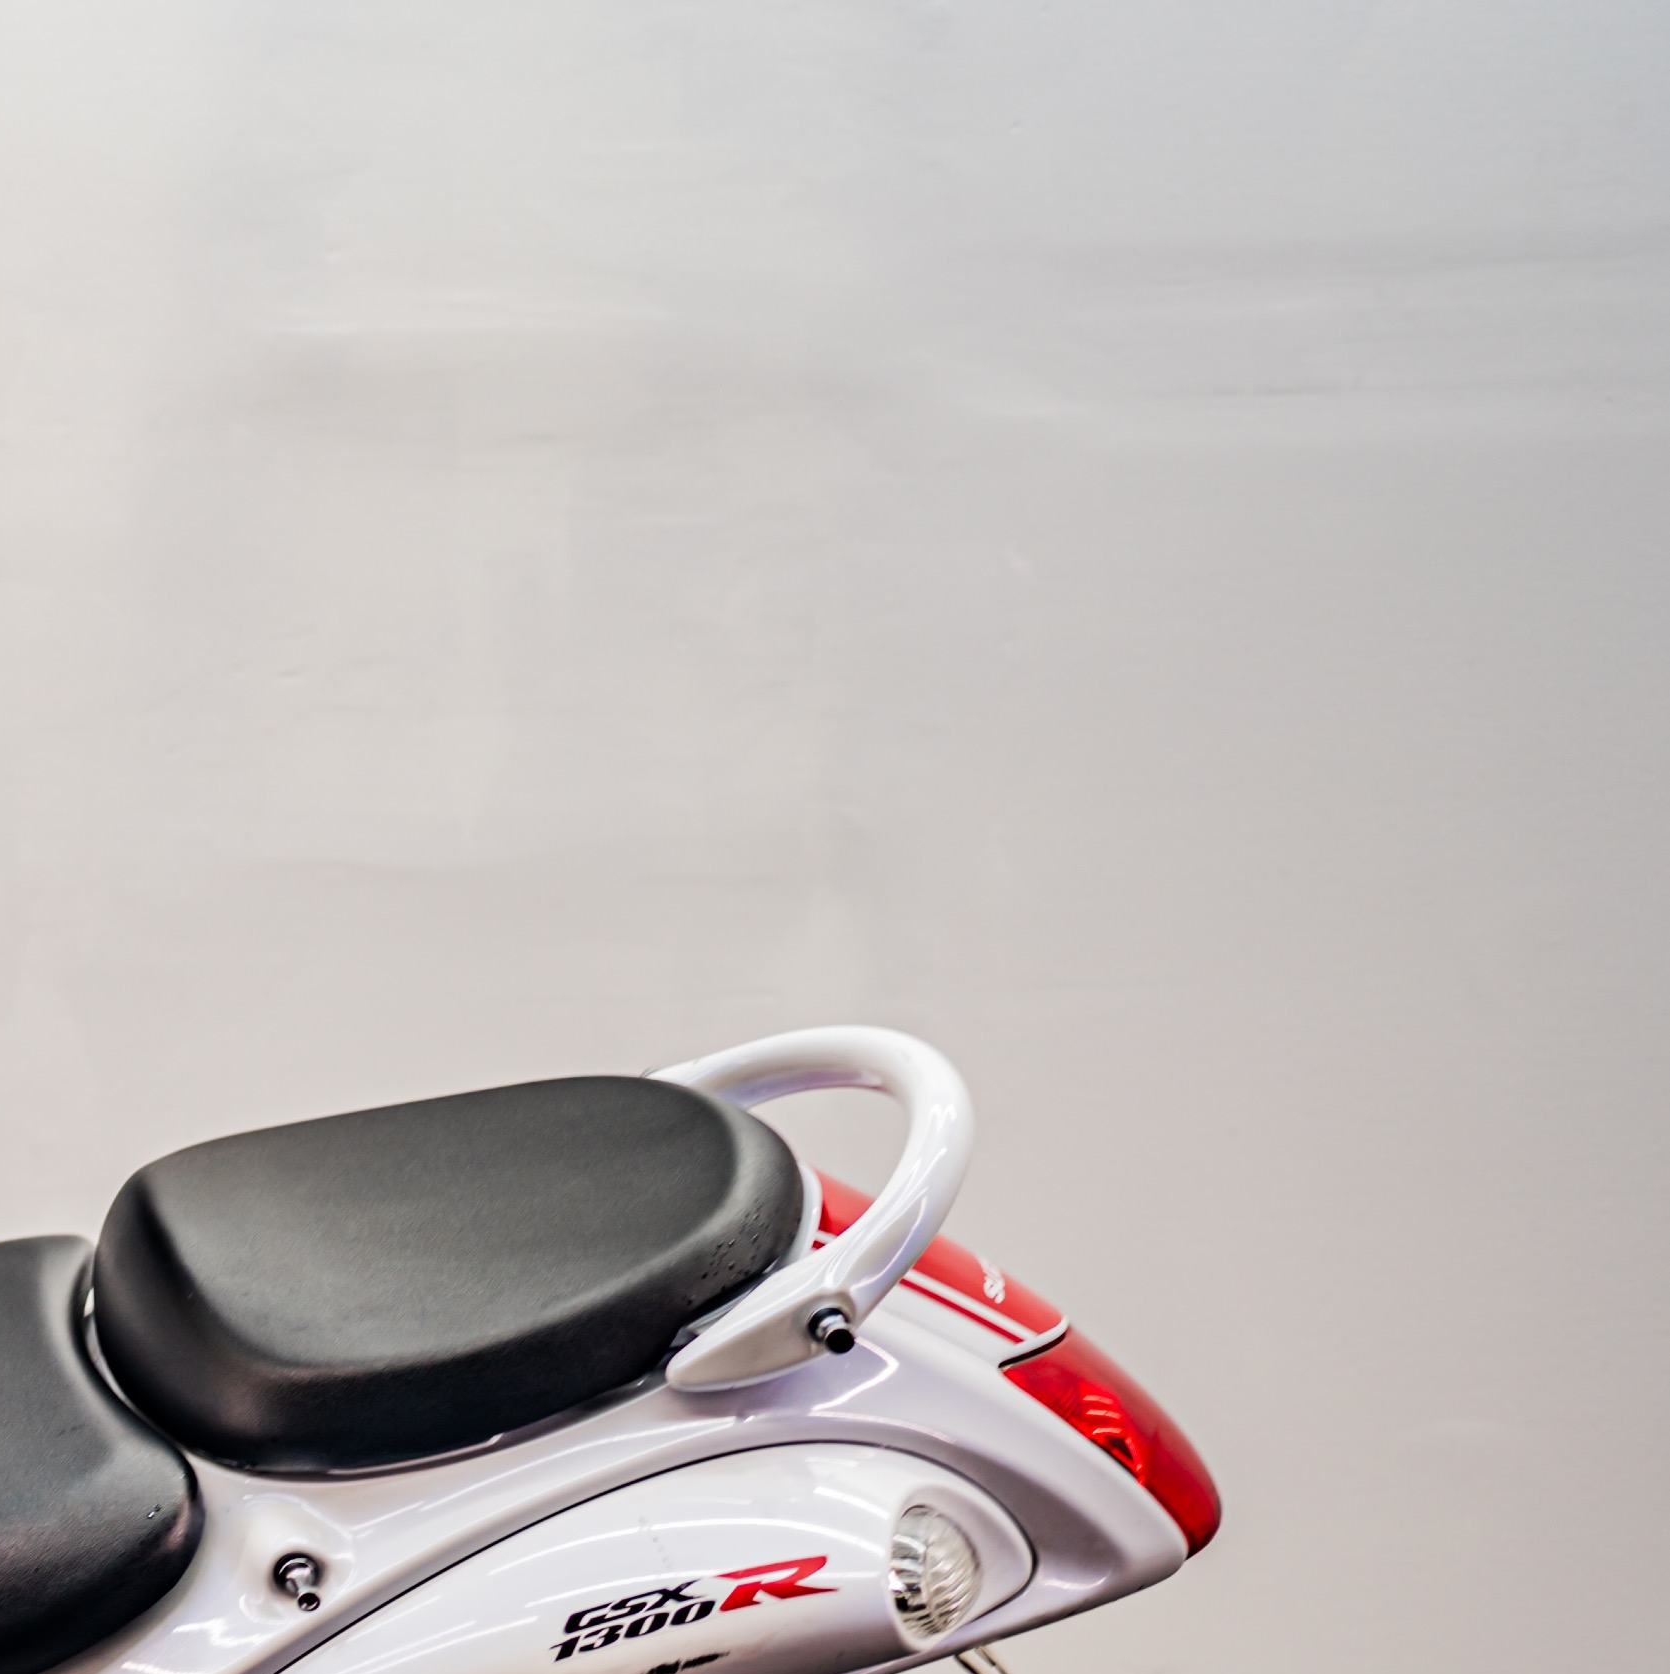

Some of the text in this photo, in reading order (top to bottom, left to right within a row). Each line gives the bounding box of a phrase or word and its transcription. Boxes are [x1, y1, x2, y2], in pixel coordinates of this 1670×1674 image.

[563, 1554, 840, 1635] GSX R
[548, 1600, 717, 1663] 1300
